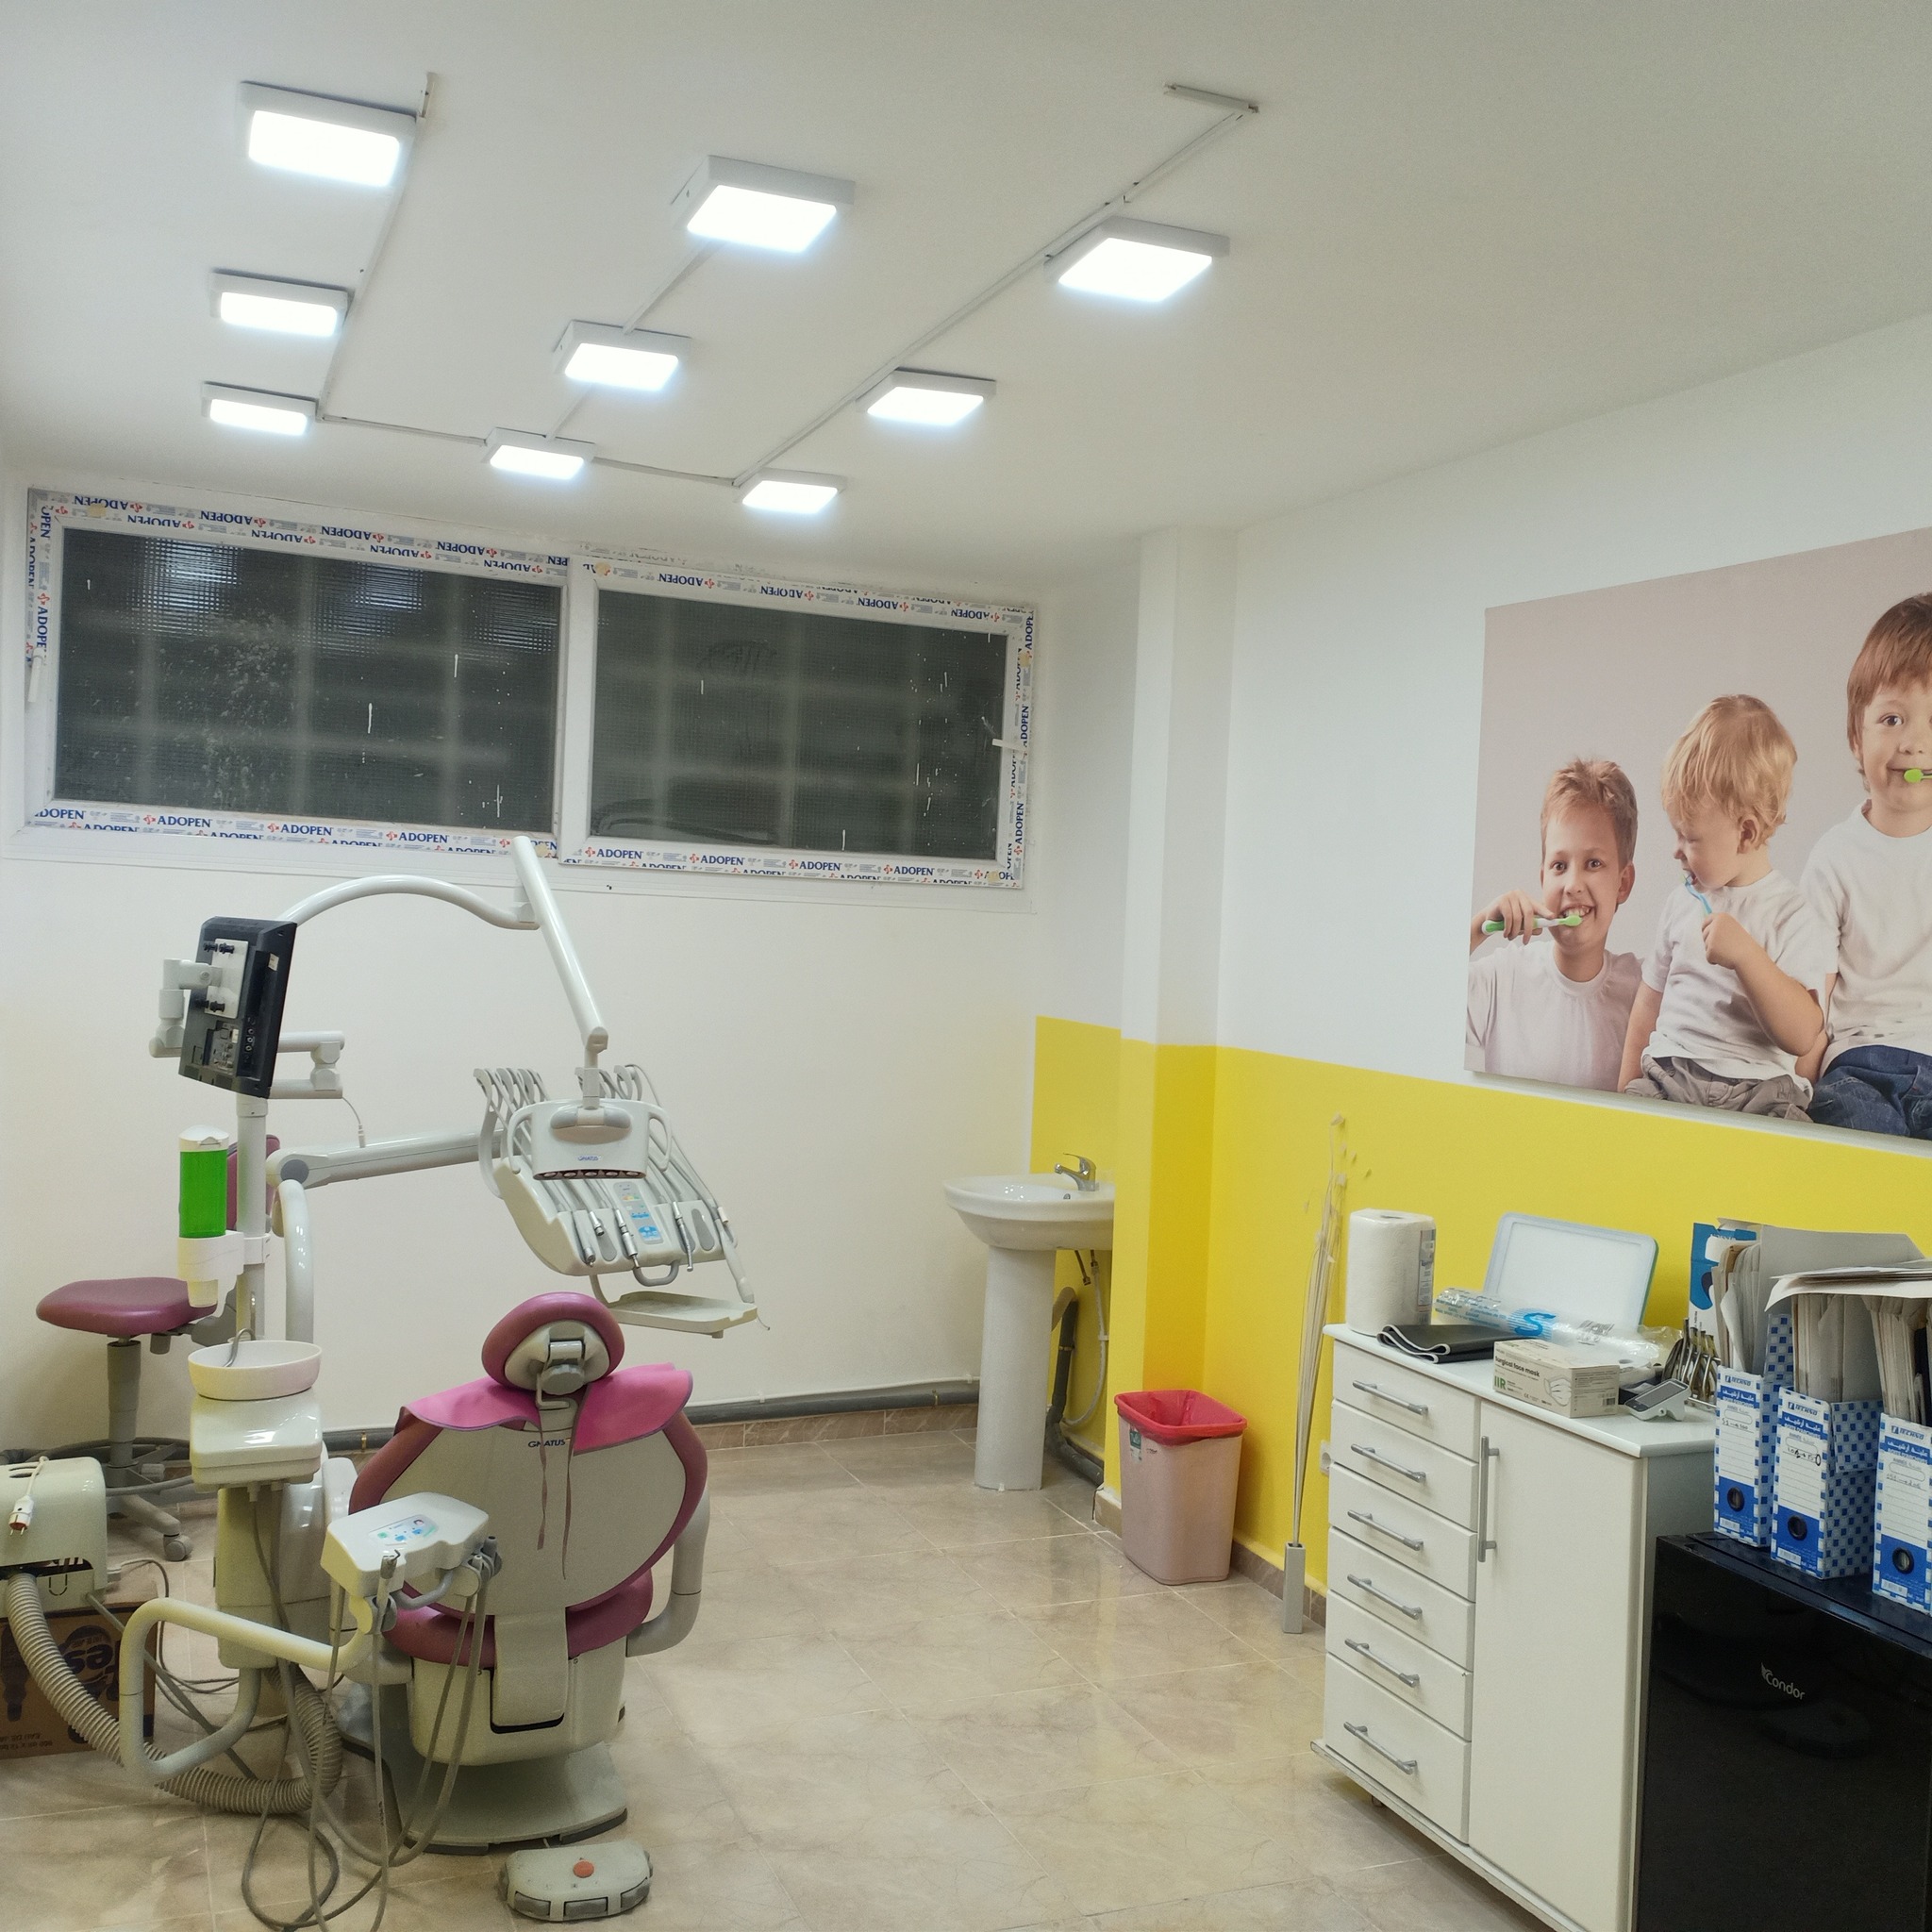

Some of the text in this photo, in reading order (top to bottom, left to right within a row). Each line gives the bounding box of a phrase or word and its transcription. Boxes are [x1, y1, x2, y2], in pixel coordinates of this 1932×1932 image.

[41, 506, 51, 539] OPEN
[201, 510, 253, 525] ADOPEN
[322, 525, 372, 541] ADOPEN
[437, 541, 485, 555] ADOPEN
[658, 574, 704, 587] ADOPEN
[761, 586, 804, 599] ADOPEN
[858, 598, 898, 609] ADOPEN
[951, 609, 990, 619] ADOPEN
[37, 606, 48, 649] ADOPE
[1025, 611, 1034, 650] ADOPE
[1021, 706, 1029, 748] ADOPEN
[158, 815, 211, 827] ADOPEN
[1015, 803, 1024, 845] ADOPEN
[281, 824, 332, 836] ADOPEN
[399, 832, 447, 843] ADOPEN
[597, 848, 642, 859] ADOPEN
[701, 855, 744, 866] ADOPEN
[799, 861, 841, 872] ADOPEN
[894, 866, 935, 876] ADOPEN
[1495, 1356, 1513, 1368] Surgical
[1514, 1362, 1524, 1373] face
[1525, 1367, 1541, 1378] mask
[1765, 1673, 1806, 1700] Condor
